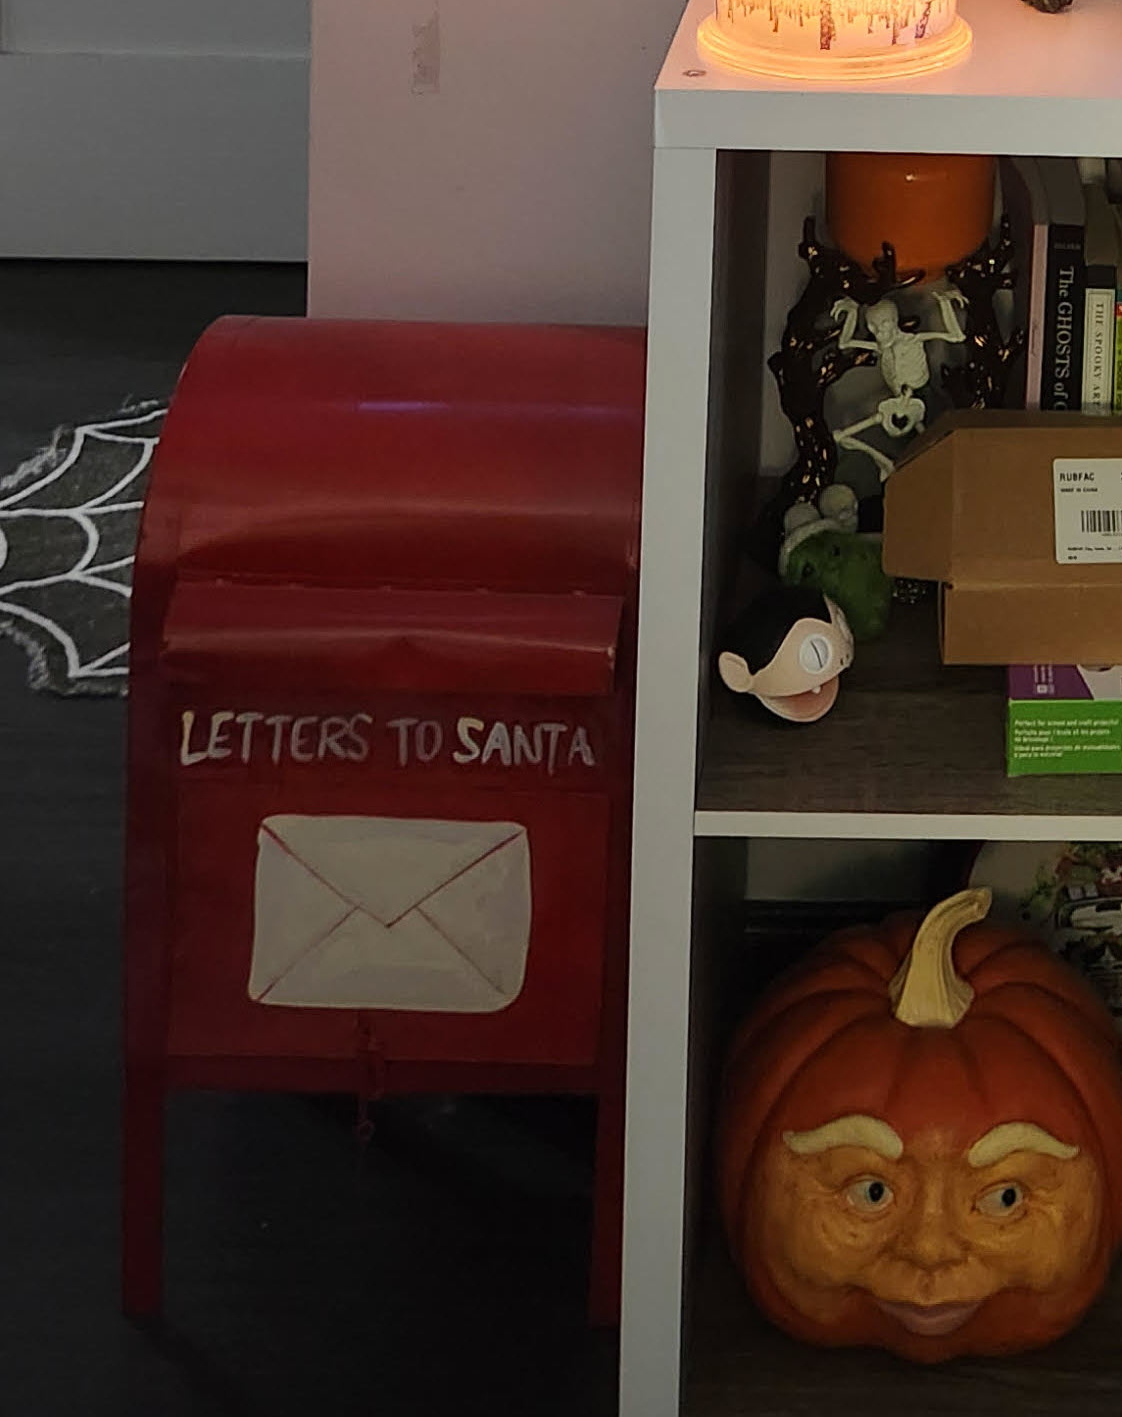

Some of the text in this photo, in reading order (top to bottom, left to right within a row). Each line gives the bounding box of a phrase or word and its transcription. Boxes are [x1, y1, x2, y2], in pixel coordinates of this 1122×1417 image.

[1057, 265, 1075, 298] The
[1054, 301, 1074, 379] GHOSTS
[1093, 330, 1104, 379] SPOOKY
[1053, 383, 1069, 400] of
[180, 710, 596, 776] LETTERS TO SANTA
